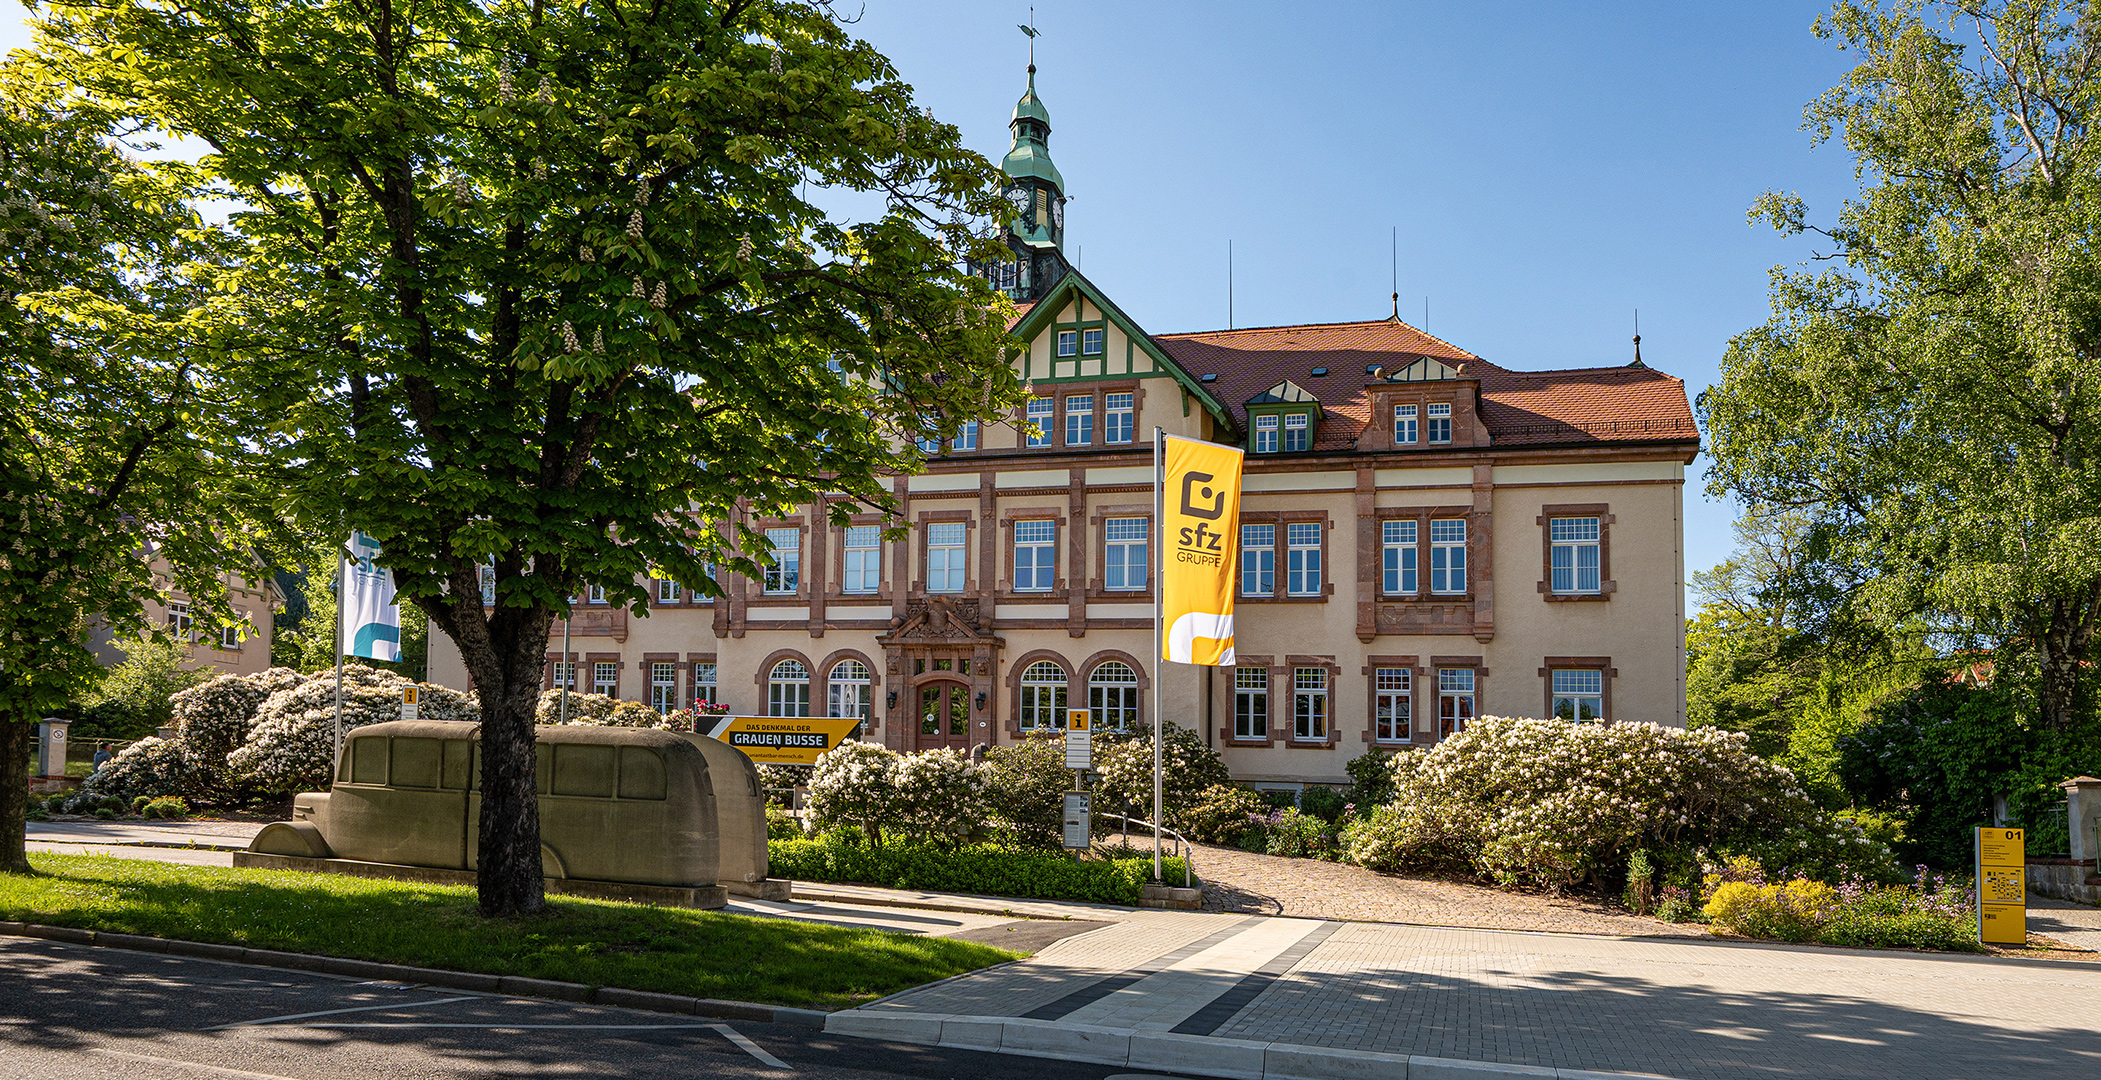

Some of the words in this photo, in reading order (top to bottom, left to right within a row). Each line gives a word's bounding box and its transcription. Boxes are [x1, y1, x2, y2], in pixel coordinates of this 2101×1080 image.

[1178, 522, 1222, 551] sfz
[1176, 551, 1221, 567] GRUPPE
[734, 733, 781, 745] GRAUEN
[785, 734, 823, 746] BUSSE
[2005, 830, 2021, 840] 01
